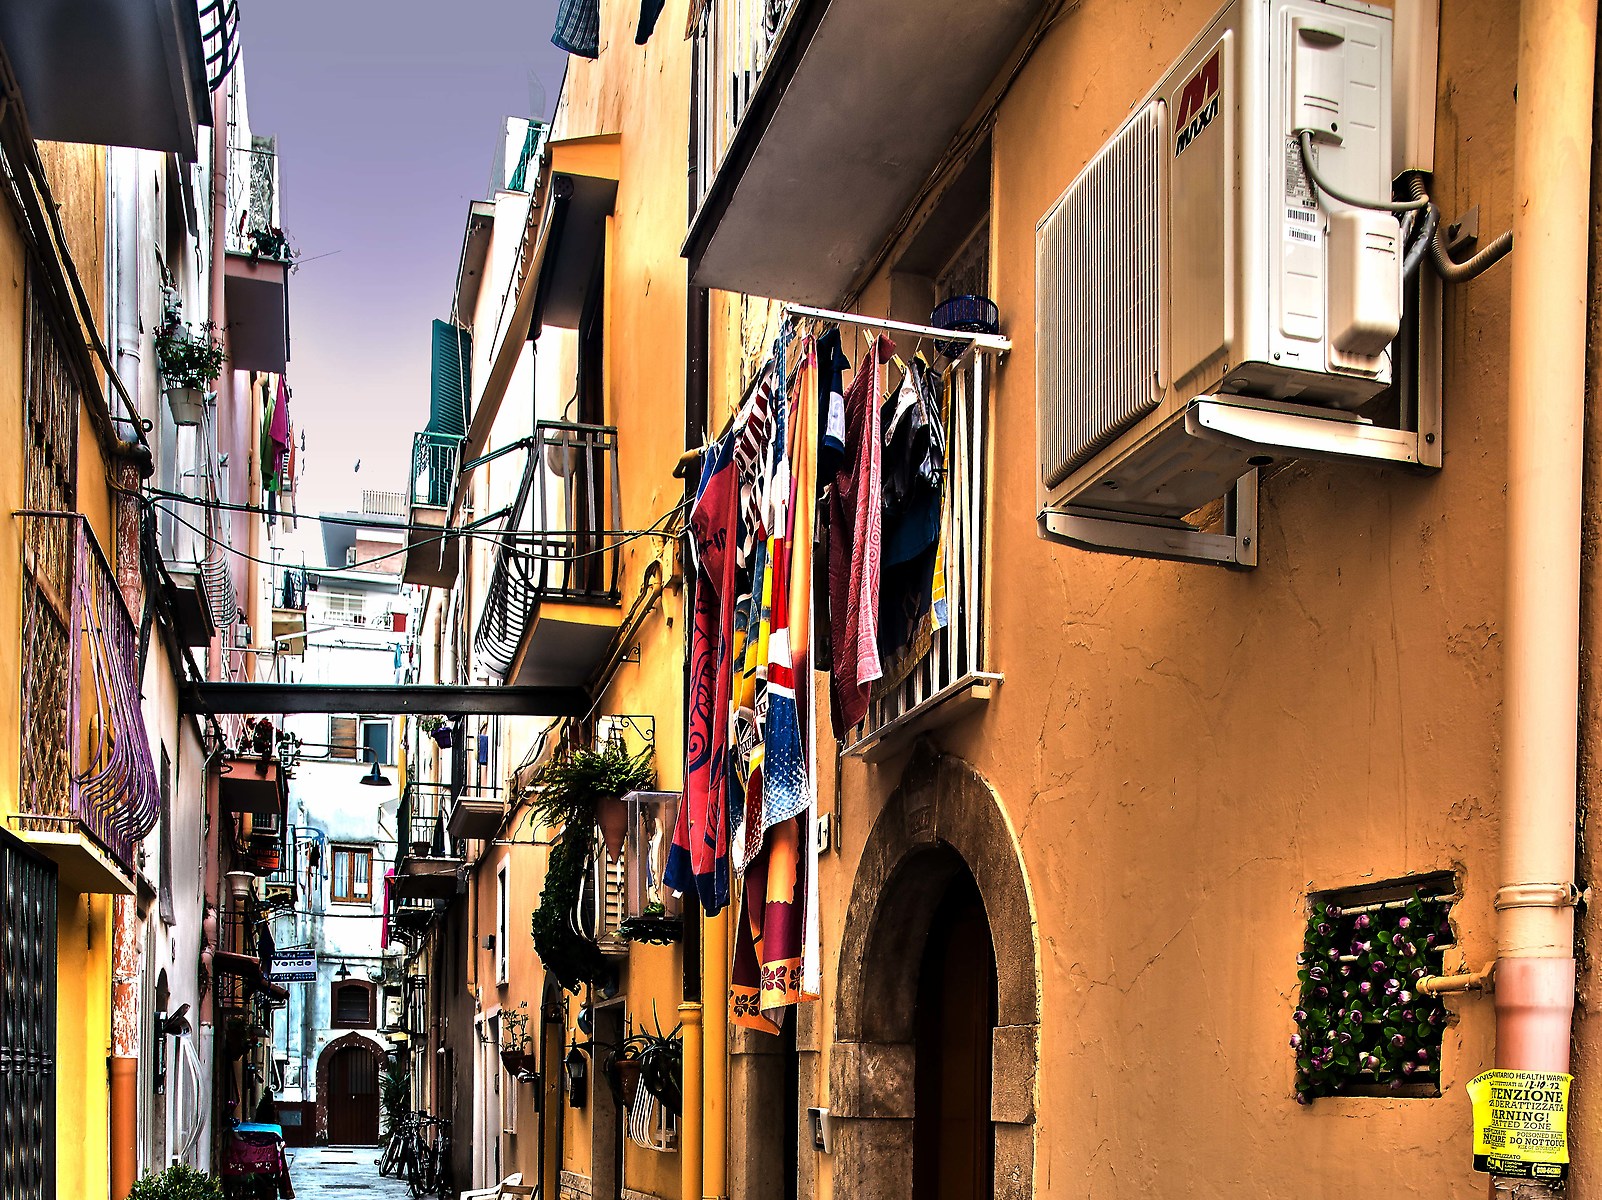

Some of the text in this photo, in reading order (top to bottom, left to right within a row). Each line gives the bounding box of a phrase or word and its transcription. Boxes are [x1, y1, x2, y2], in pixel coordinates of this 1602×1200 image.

[1516, 1073, 1545, 1081] HEALTH
[1495, 1100, 1564, 1112] DERATTIZZATA
[1492, 1108, 1549, 1122] ARNING!
[1523, 1121, 1551, 1131] ZONE
[1510, 1137, 1523, 1145] DO
[1525, 1138, 1543, 1146] NOT
